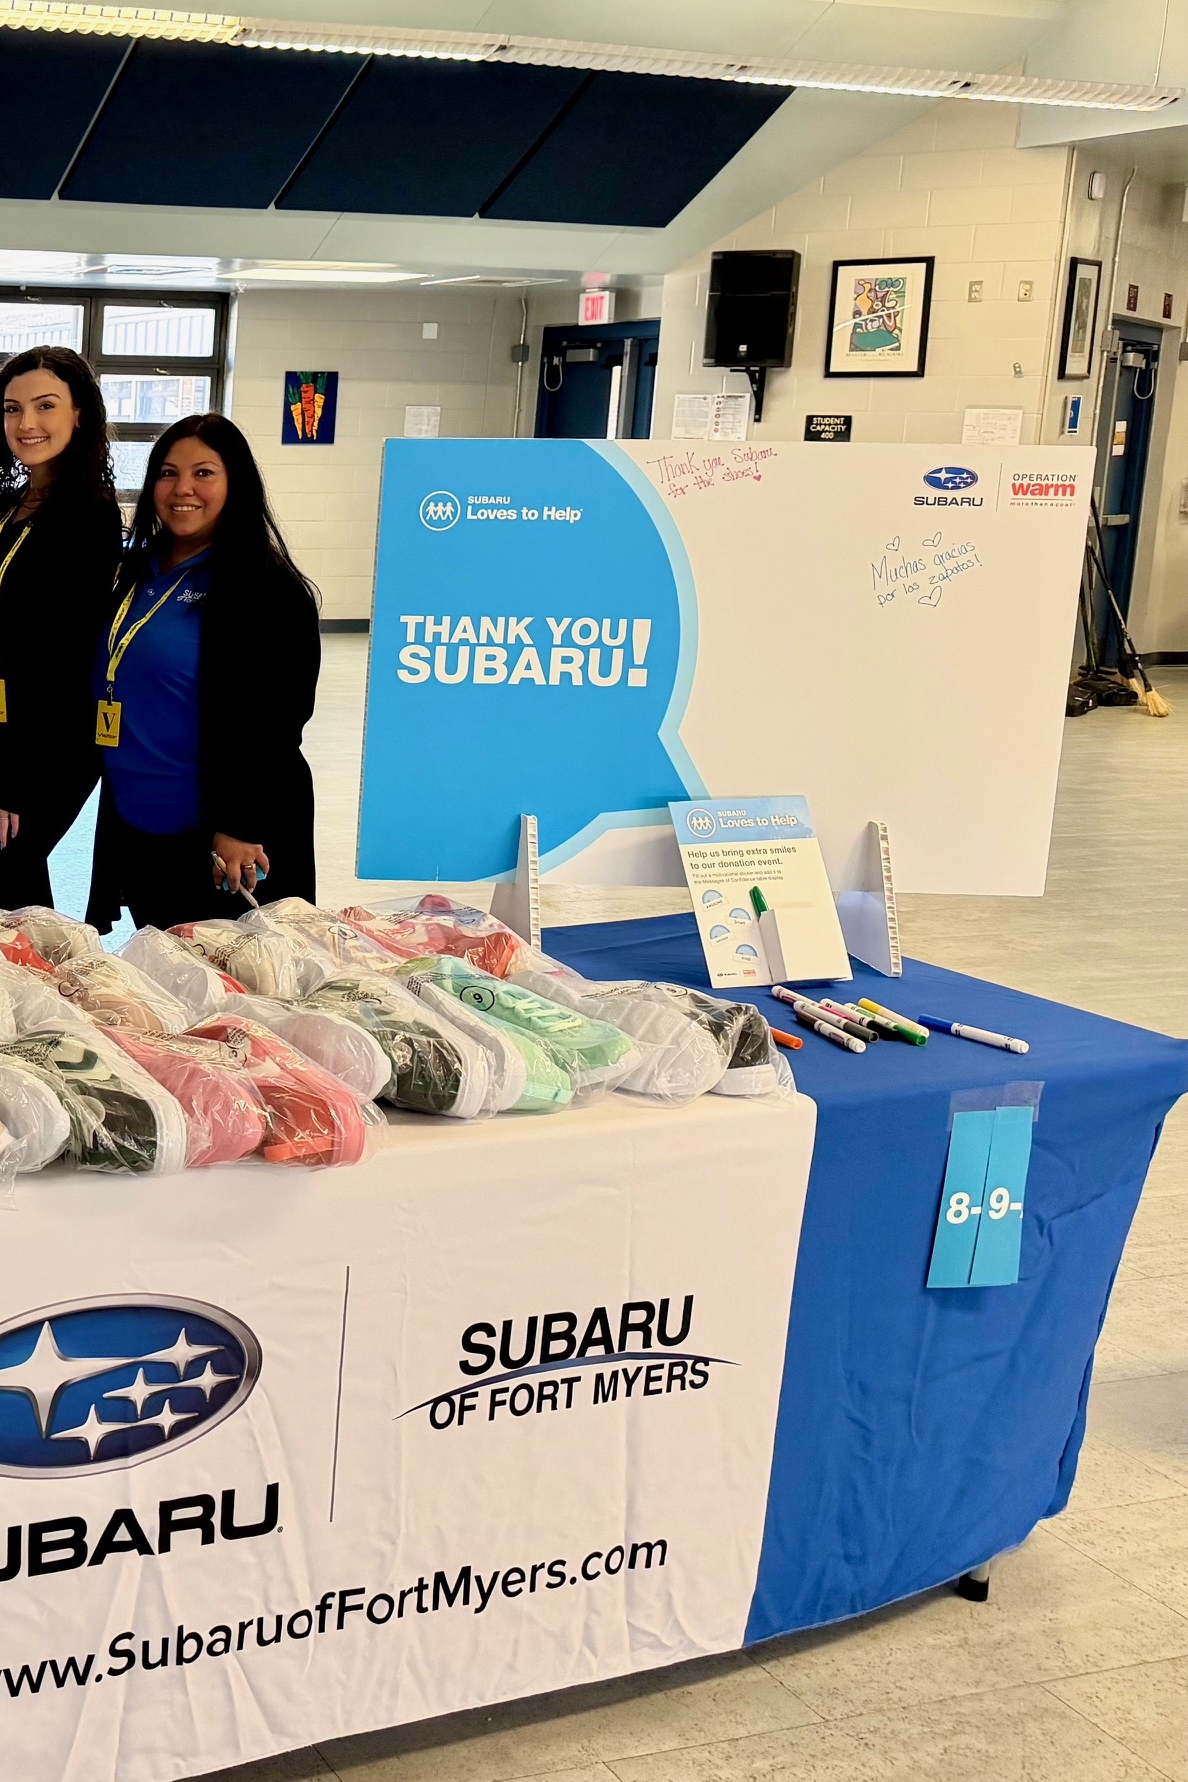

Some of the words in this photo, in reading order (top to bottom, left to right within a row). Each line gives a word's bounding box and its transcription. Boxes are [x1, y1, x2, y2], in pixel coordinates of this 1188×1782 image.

[584, 296, 604, 321] EXIT
[813, 417, 845, 425] STUDENT
[647, 452, 699, 483] Thank
[703, 457, 724, 477] you
[668, 482, 688, 498] for
[693, 475, 714, 489] the
[722, 461, 759, 481] shoes!
[1013, 473, 1077, 482] OPERATION
[1011, 482, 1075, 497] warm
[467, 496, 510, 504] SUBARU
[913, 496, 983, 507] SUBARU
[466, 506, 517, 520] Loves
[521, 507, 538, 521] to
[542, 507, 582, 524] Help
[871, 555, 927, 591] Muchas
[933, 541, 976, 571] gracias
[877, 589, 897, 608] por
[903, 582, 920, 594] los
[929, 554, 983, 585] zapatos!
[399, 615, 534, 645] THANK
[545, 617, 627, 646] YOU
[101, 712, 117, 732] V
[717, 809, 747, 817] SUBARU
[719, 817, 754, 828] Loves
[756, 817, 769, 827] to
[771, 815, 797, 827] Help
[687, 850, 708, 860] Help
[709, 850, 720, 858] us
[722, 848, 744, 858] bring
[746, 847, 768, 855] extra
[770, 846, 797, 854] smiles
[690, 862, 700, 870] to
[718, 860, 756, 868] donation
[757, 858, 783, 866] event.
[946, 1192, 982, 1225] 8-
[460, 1296, 694, 1376] SUBARU
[429, 1391, 480, 1431] OF
[489, 1376, 584, 1422] FORT
[592, 1359, 711, 1403] MYERS
